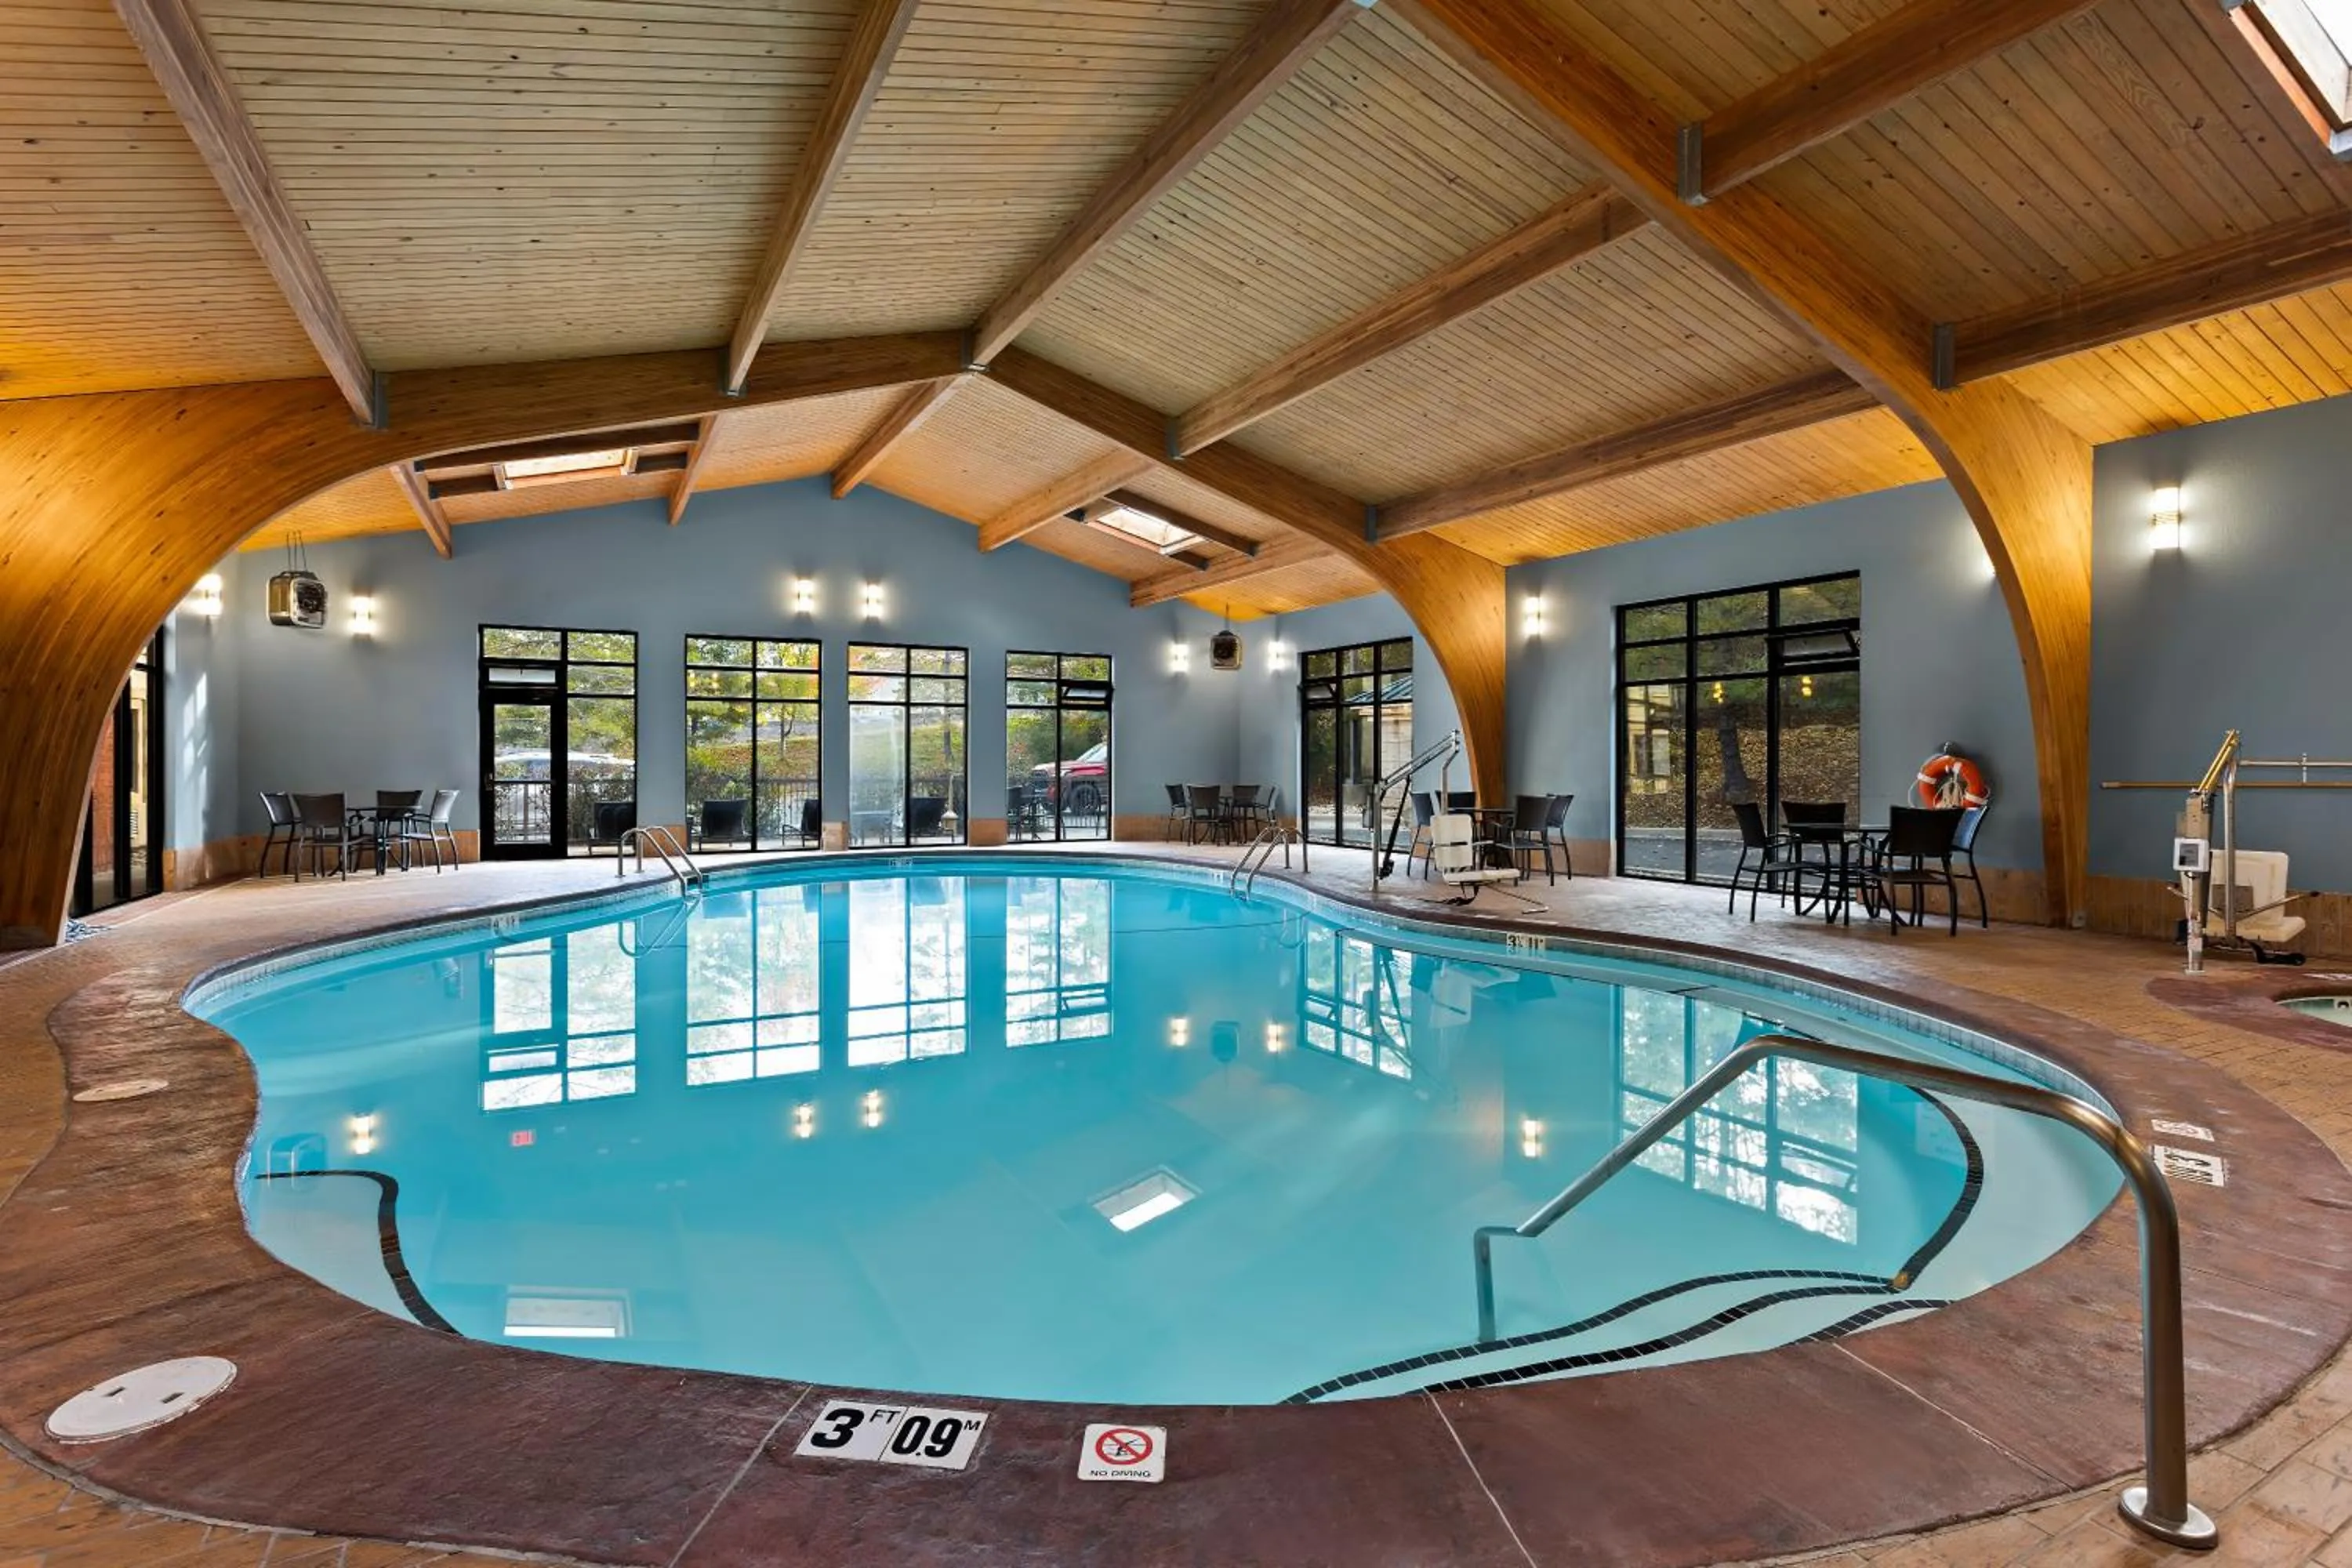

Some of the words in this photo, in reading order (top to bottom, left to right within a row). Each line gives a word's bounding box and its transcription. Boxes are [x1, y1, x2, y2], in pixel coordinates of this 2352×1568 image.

[810, 1408, 865, 1449] 3
[869, 1409, 901, 1425] FT
[891, 1415, 964, 1457] 0.9
[964, 1420, 981, 1431] M
